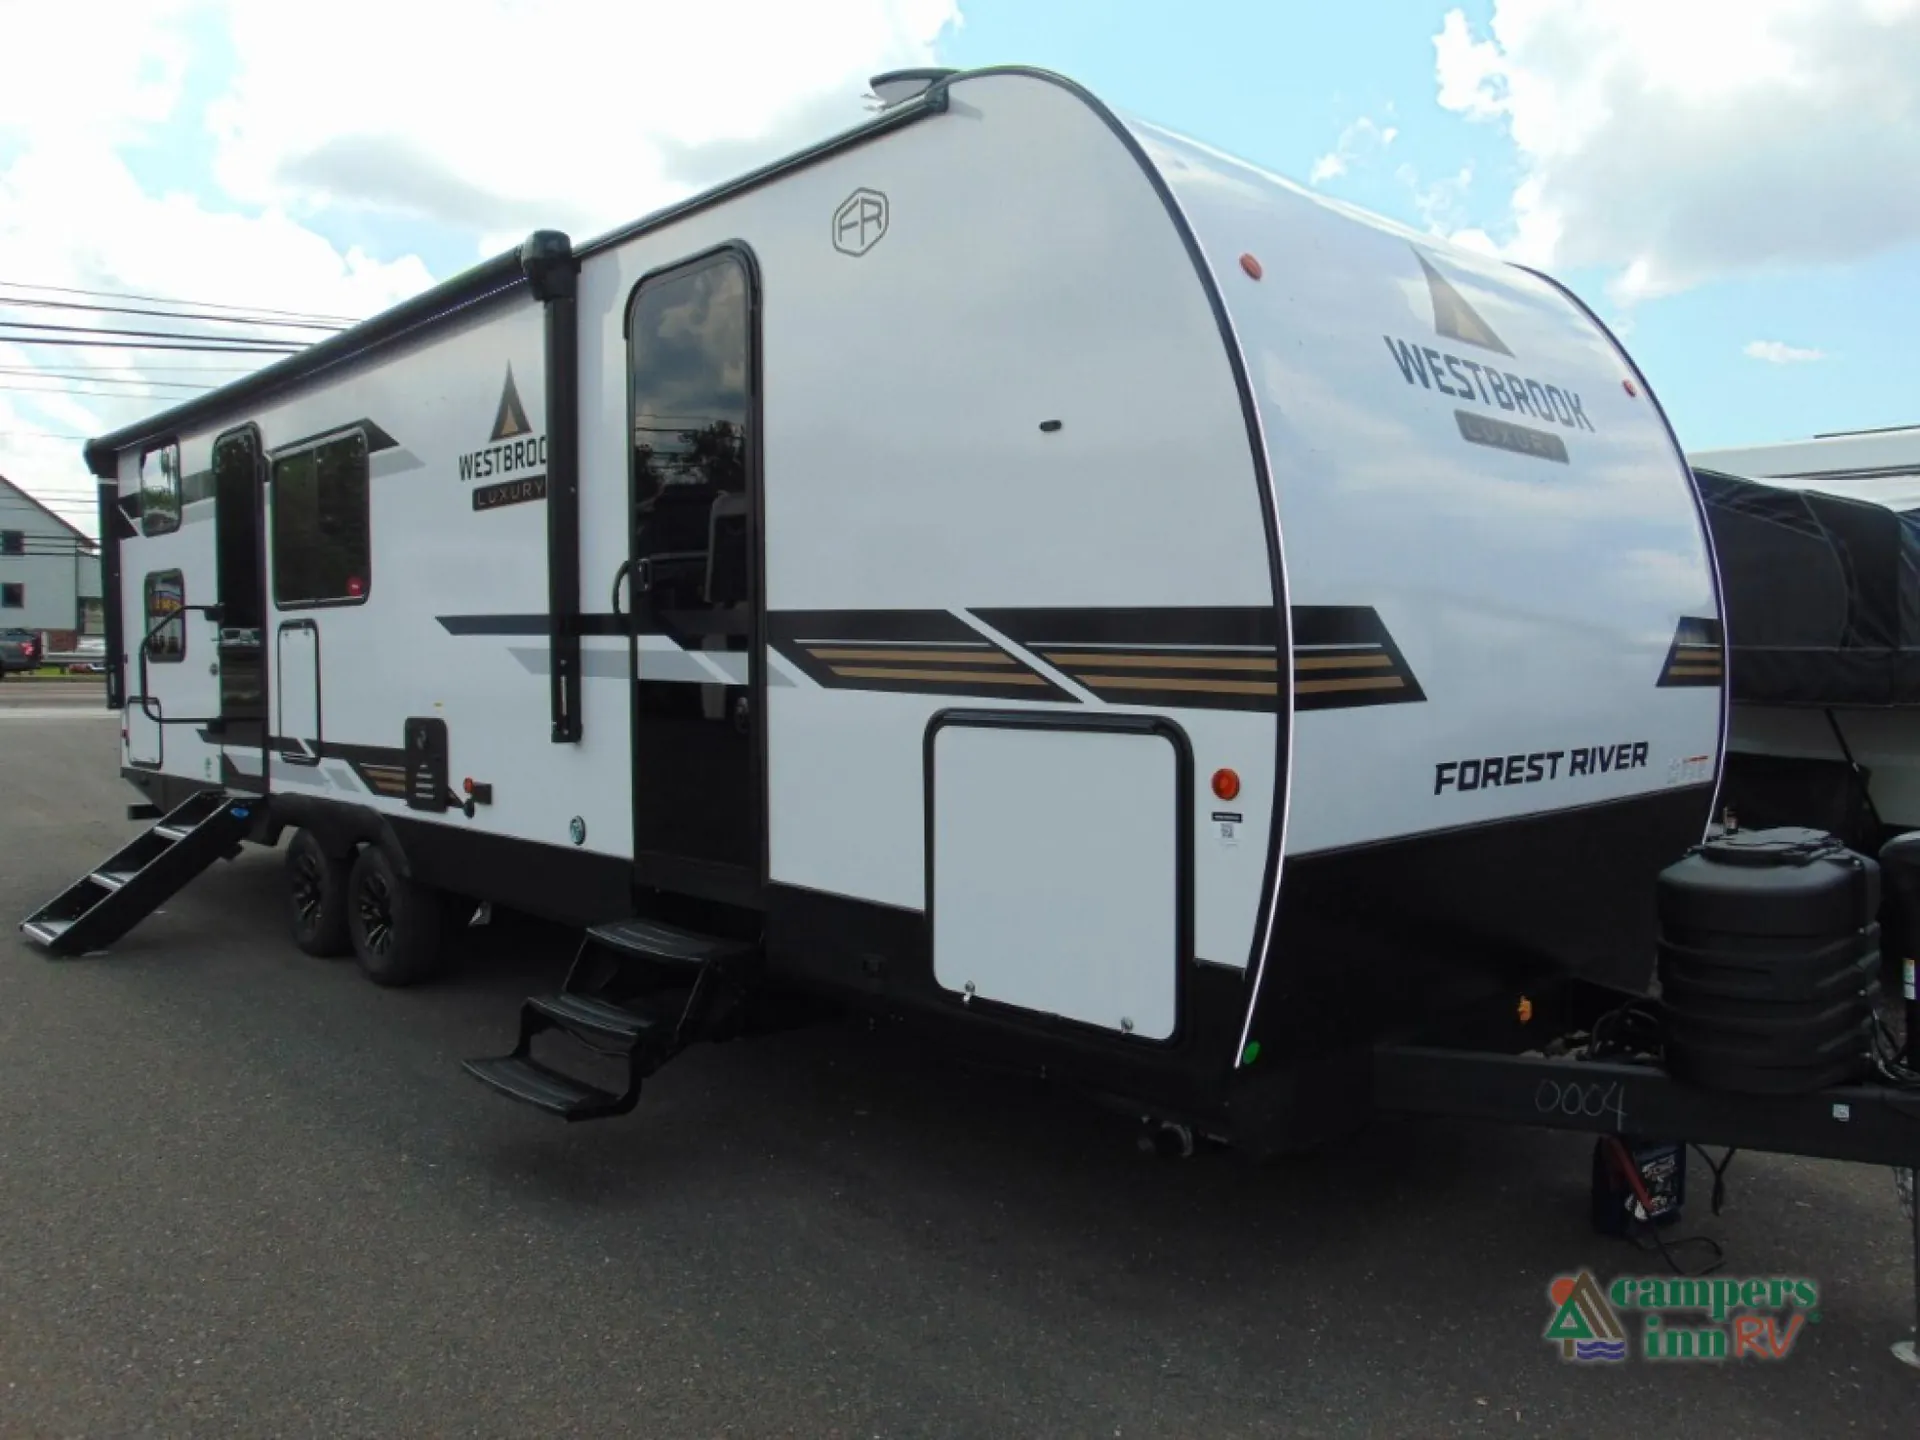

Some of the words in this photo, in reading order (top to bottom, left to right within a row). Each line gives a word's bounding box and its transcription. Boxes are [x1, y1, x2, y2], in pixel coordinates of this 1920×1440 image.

[1383, 335, 1595, 433] WESTBROOK
[459, 435, 547, 481] WESTBROO
[477, 480, 544, 506] LUXURY
[1434, 751, 1565, 795] FOREST
[1569, 741, 1648, 777] RIVER
[1535, 1079, 1628, 1131] 0004
